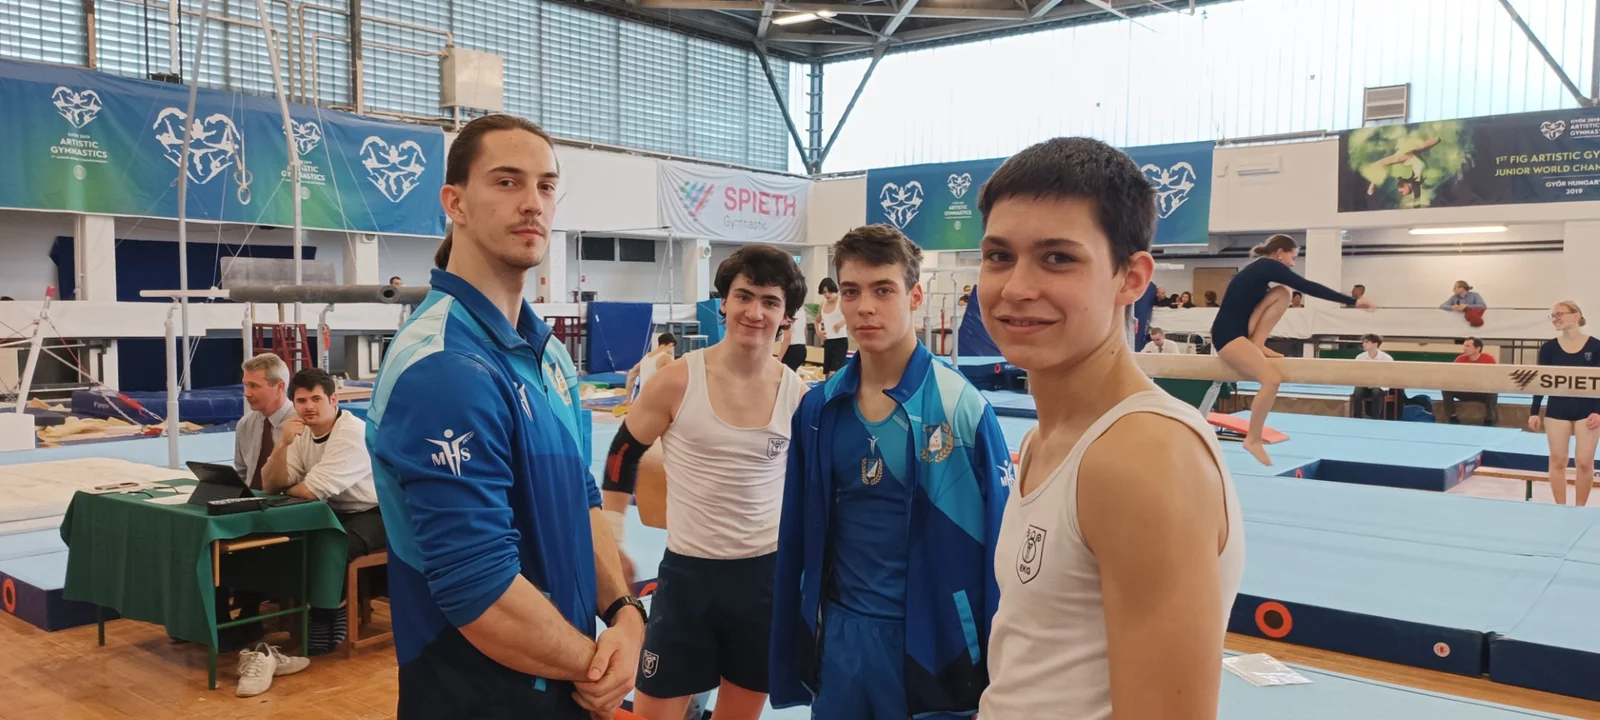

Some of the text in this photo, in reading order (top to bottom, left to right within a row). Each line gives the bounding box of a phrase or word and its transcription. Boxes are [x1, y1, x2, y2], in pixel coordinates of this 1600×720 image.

[60, 137, 99, 149] ARTISTIC
[50, 145, 108, 159] GYMNASTICS
[1510, 154, 1528, 164] FIG
[1530, 151, 1581, 163] ARTISTIC
[1494, 166, 1530, 177] JUNIOR
[1532, 165, 1571, 175] WORLD
[724, 186, 797, 217] SPIETH
